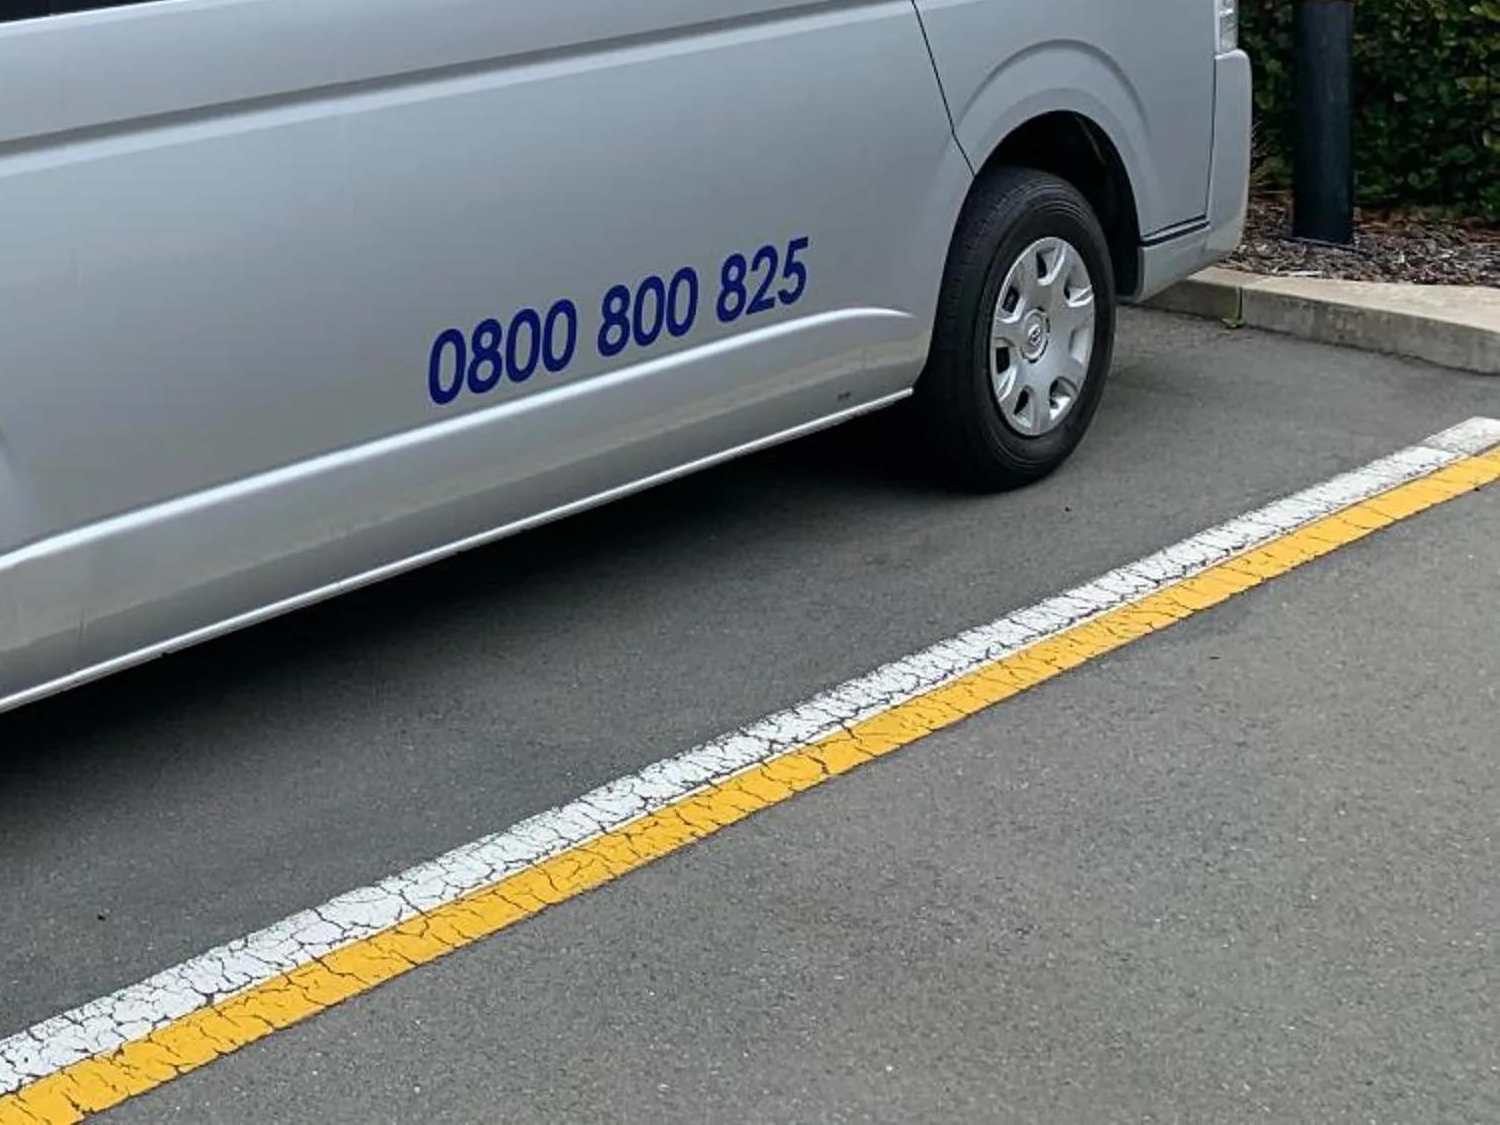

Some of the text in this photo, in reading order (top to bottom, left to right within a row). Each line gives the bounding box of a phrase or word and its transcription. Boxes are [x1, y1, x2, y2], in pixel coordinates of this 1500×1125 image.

[427, 235, 809, 405] 0800 800 825
